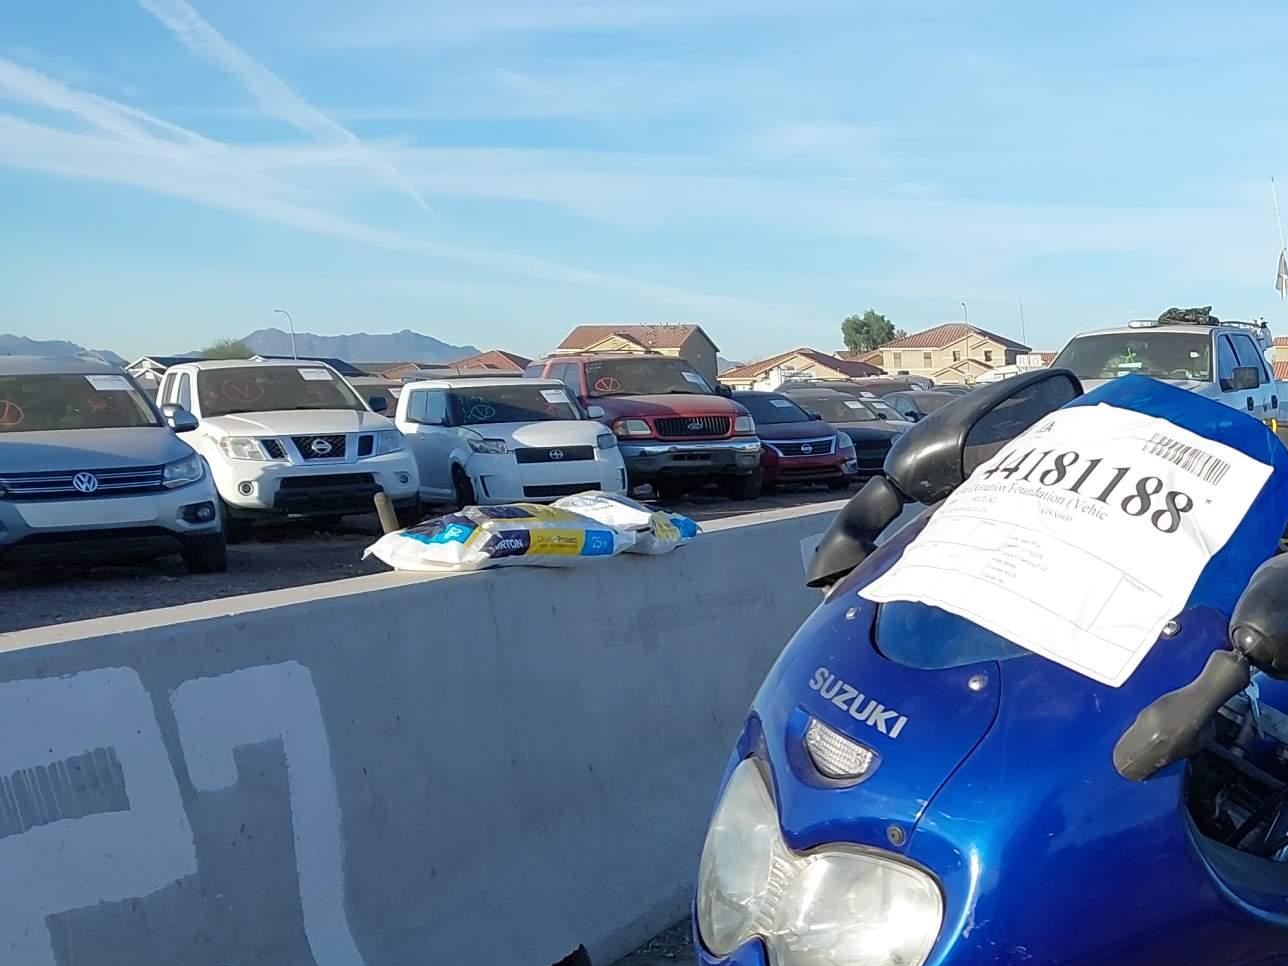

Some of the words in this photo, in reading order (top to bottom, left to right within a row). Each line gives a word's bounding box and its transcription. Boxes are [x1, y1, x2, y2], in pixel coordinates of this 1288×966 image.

[983, 447, 1194, 534] 44181188
[1007, 482, 1065, 505] Foundation
[808, 667, 908, 738] SUZUKI
